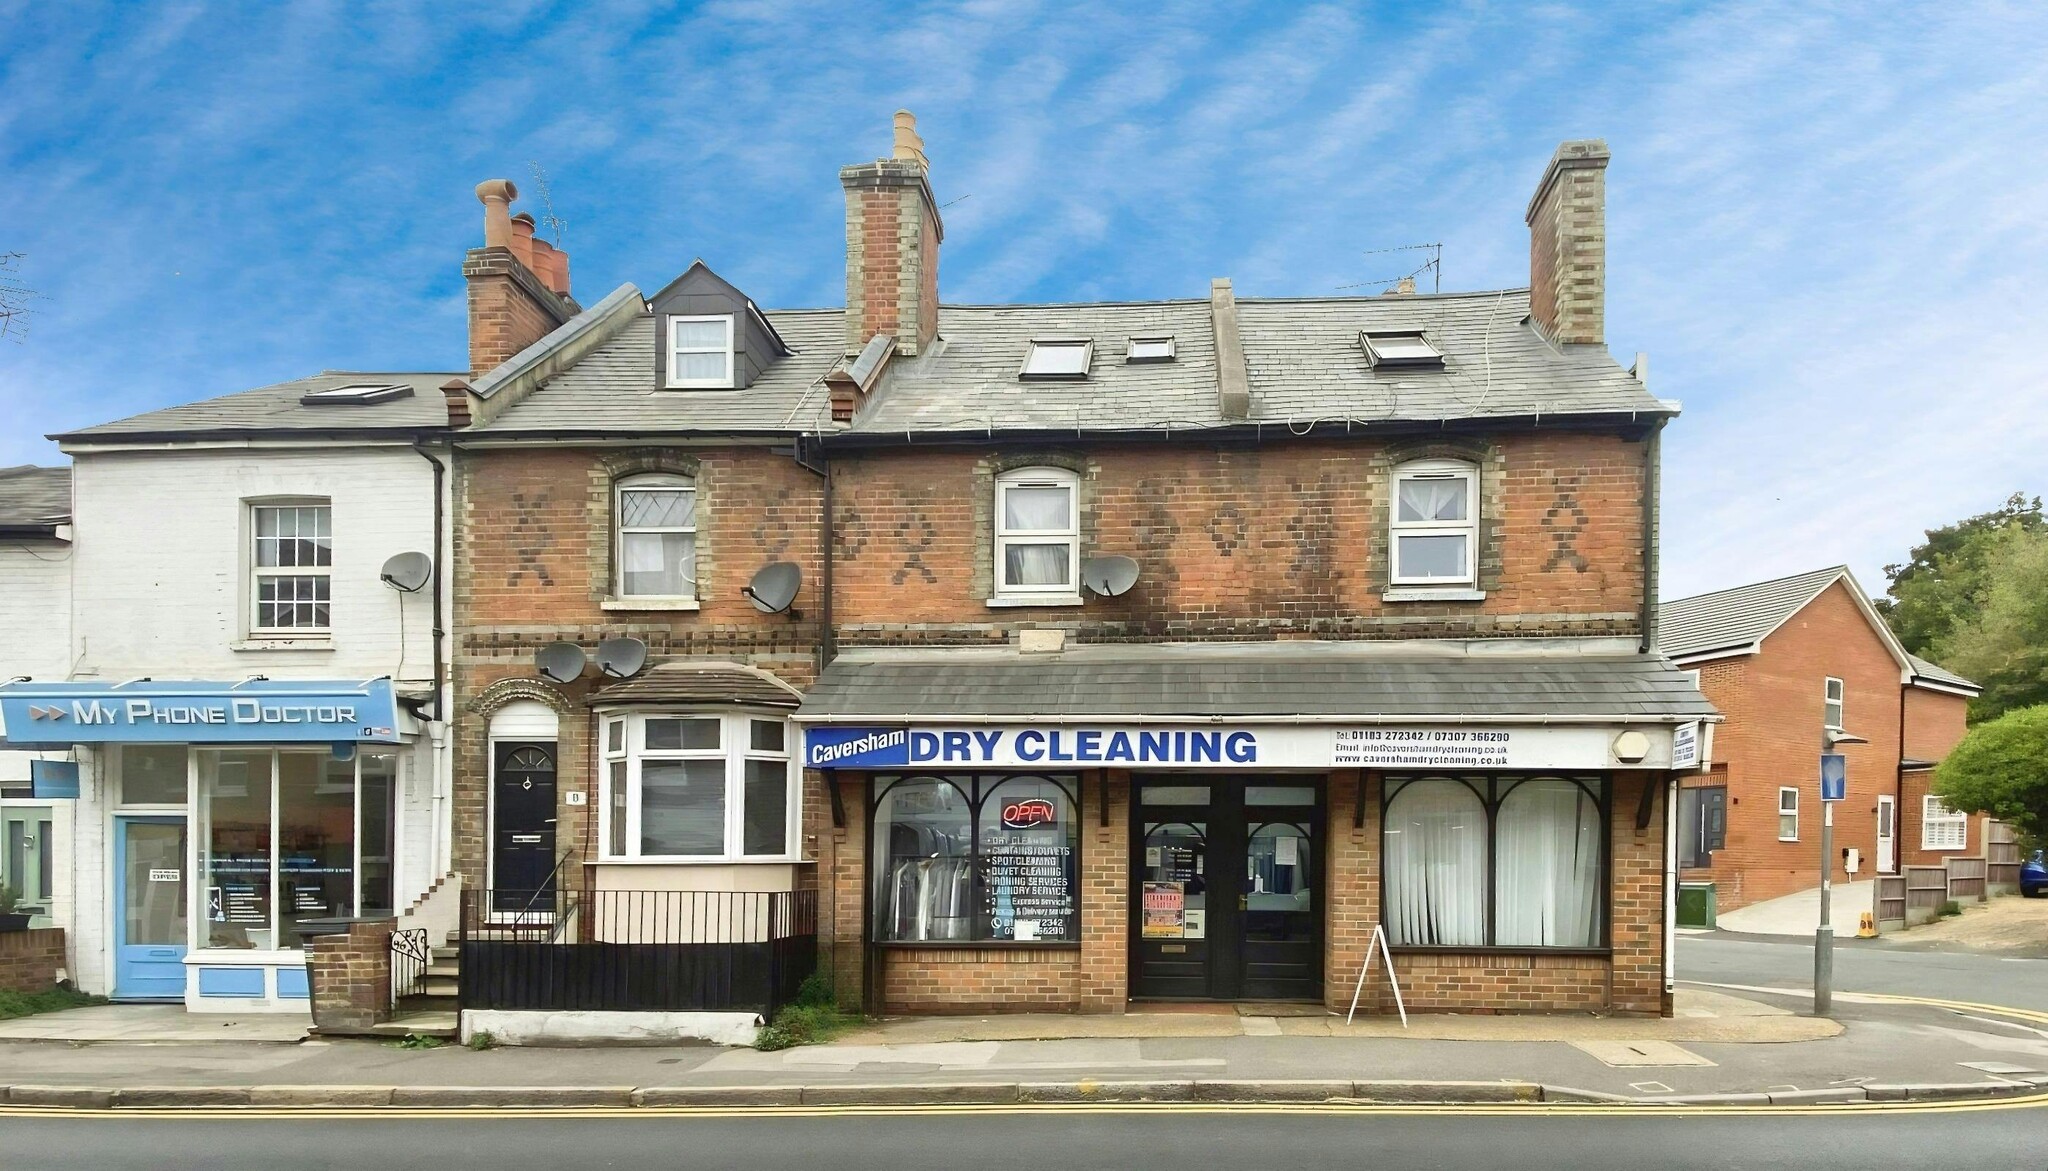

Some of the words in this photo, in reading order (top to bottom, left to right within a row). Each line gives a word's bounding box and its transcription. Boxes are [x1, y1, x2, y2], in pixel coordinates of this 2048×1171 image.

[812, 730, 904, 764] Caversham
[910, 731, 1003, 762] DRY
[1014, 730, 1257, 763] CLEANING
[1385, 731, 1424, 741] 272342
[1434, 732, 1467, 742] 07307
[1003, 805, 1053, 822] OPEN
